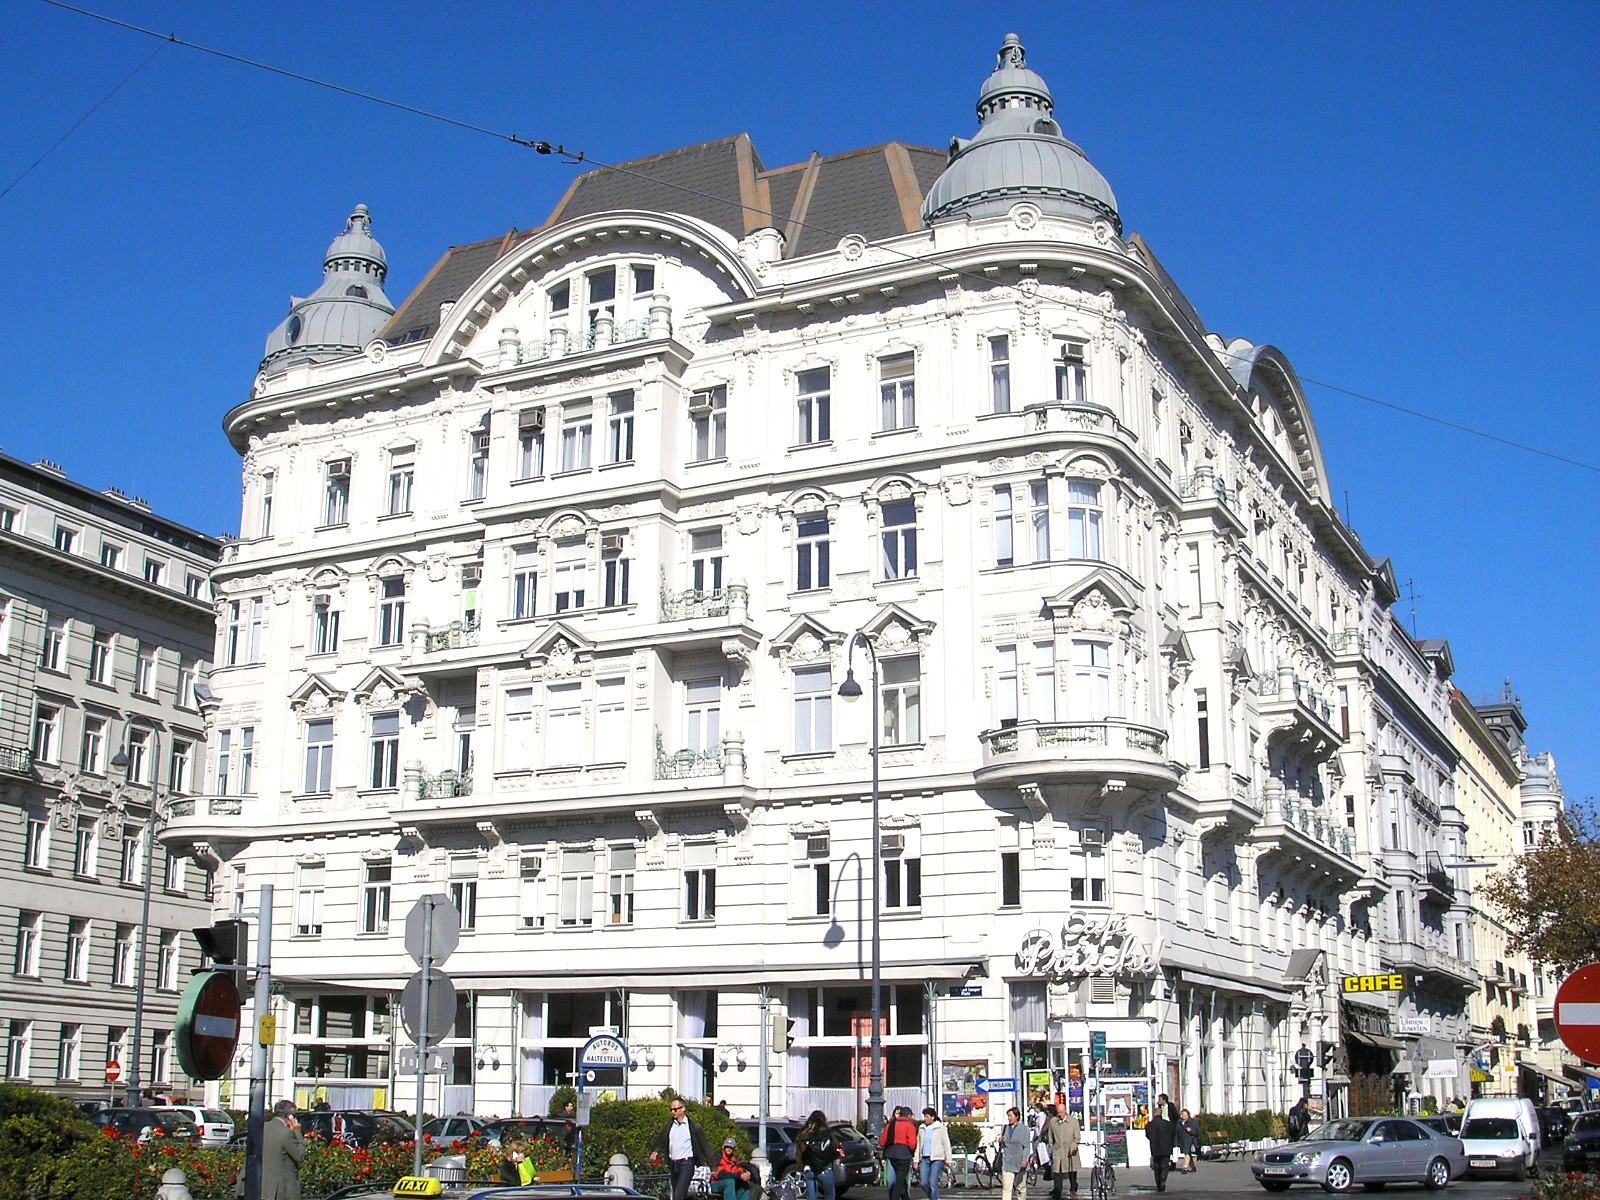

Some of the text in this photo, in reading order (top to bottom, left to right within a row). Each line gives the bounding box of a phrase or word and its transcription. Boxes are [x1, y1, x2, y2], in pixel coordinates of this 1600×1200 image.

[1063, 911, 1130, 946] Café
[1345, 975, 1403, 991] CAFE
[592, 1039, 619, 1051] AUTOBUS
[586, 1055, 623, 1063] HALTESTELLE
[401, 1180, 428, 1191] TAXI
